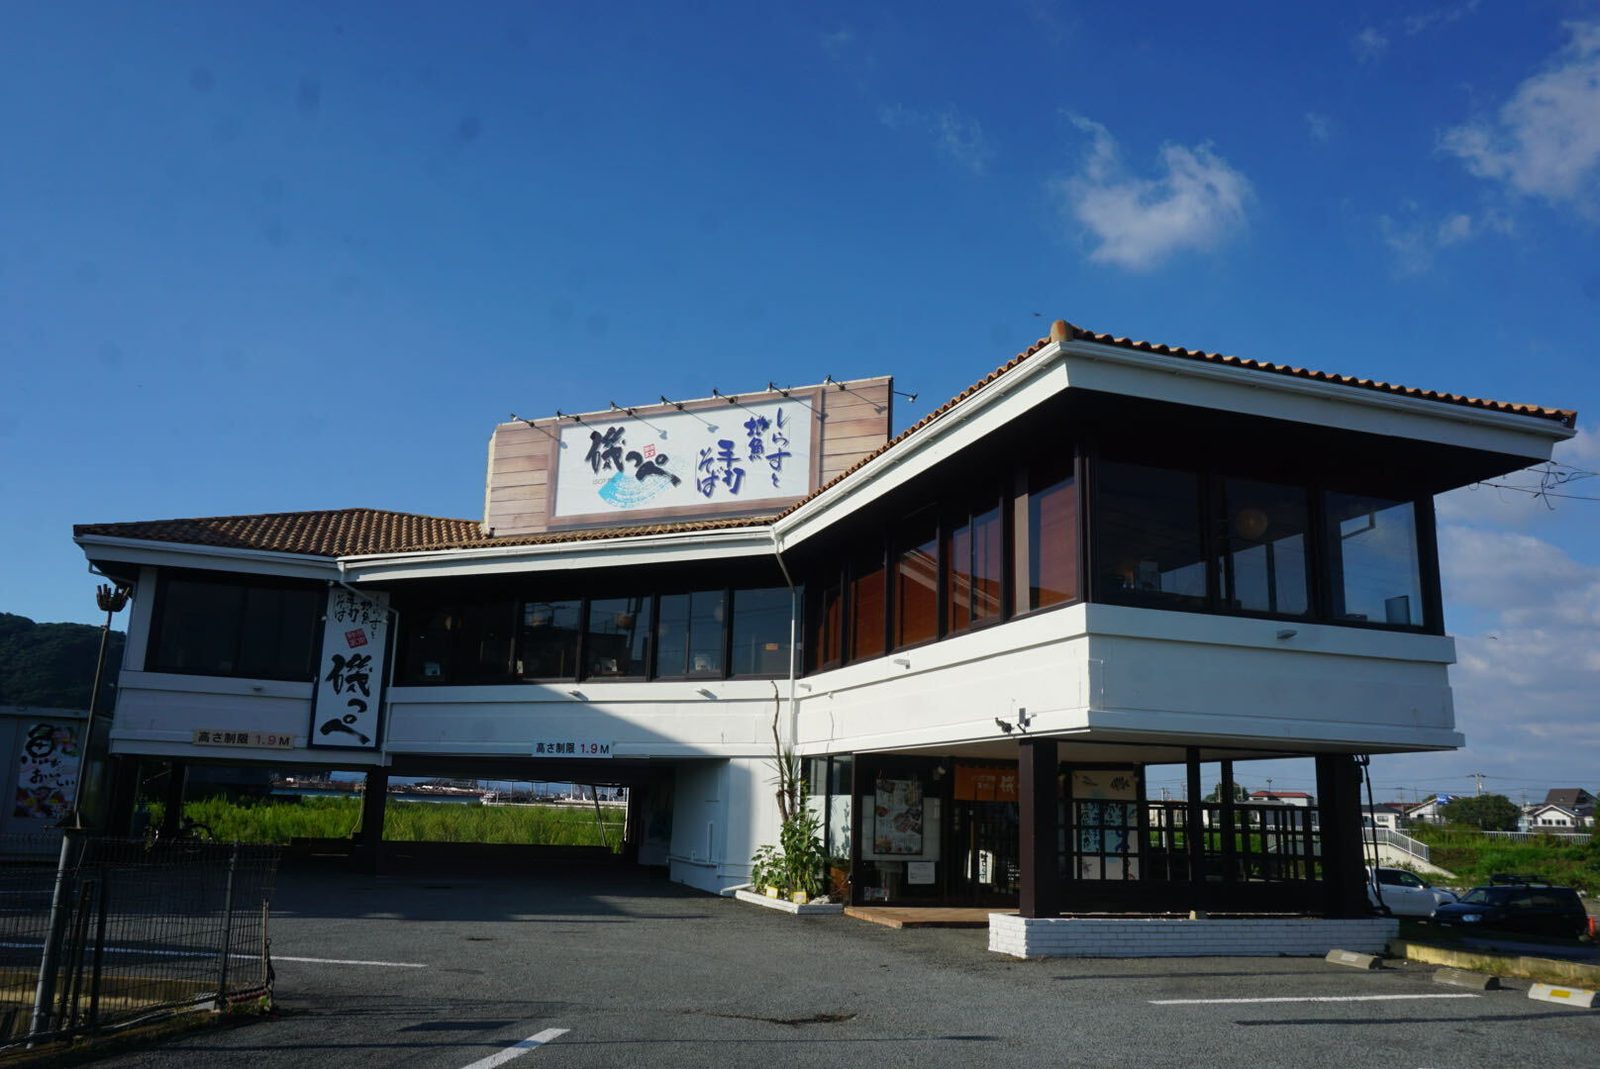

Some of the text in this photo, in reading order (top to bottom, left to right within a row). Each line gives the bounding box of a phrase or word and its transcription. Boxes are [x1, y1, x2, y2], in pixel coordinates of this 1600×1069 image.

[585, 426, 682, 488] 磯っぺ
[744, 416, 770, 461] 地魚
[765, 407, 792, 488] しらすと
[320, 653, 373, 744] 磯っぺ
[198, 732, 248, 744] 高さ制限
[536, 742, 575, 754] 高さ制限
